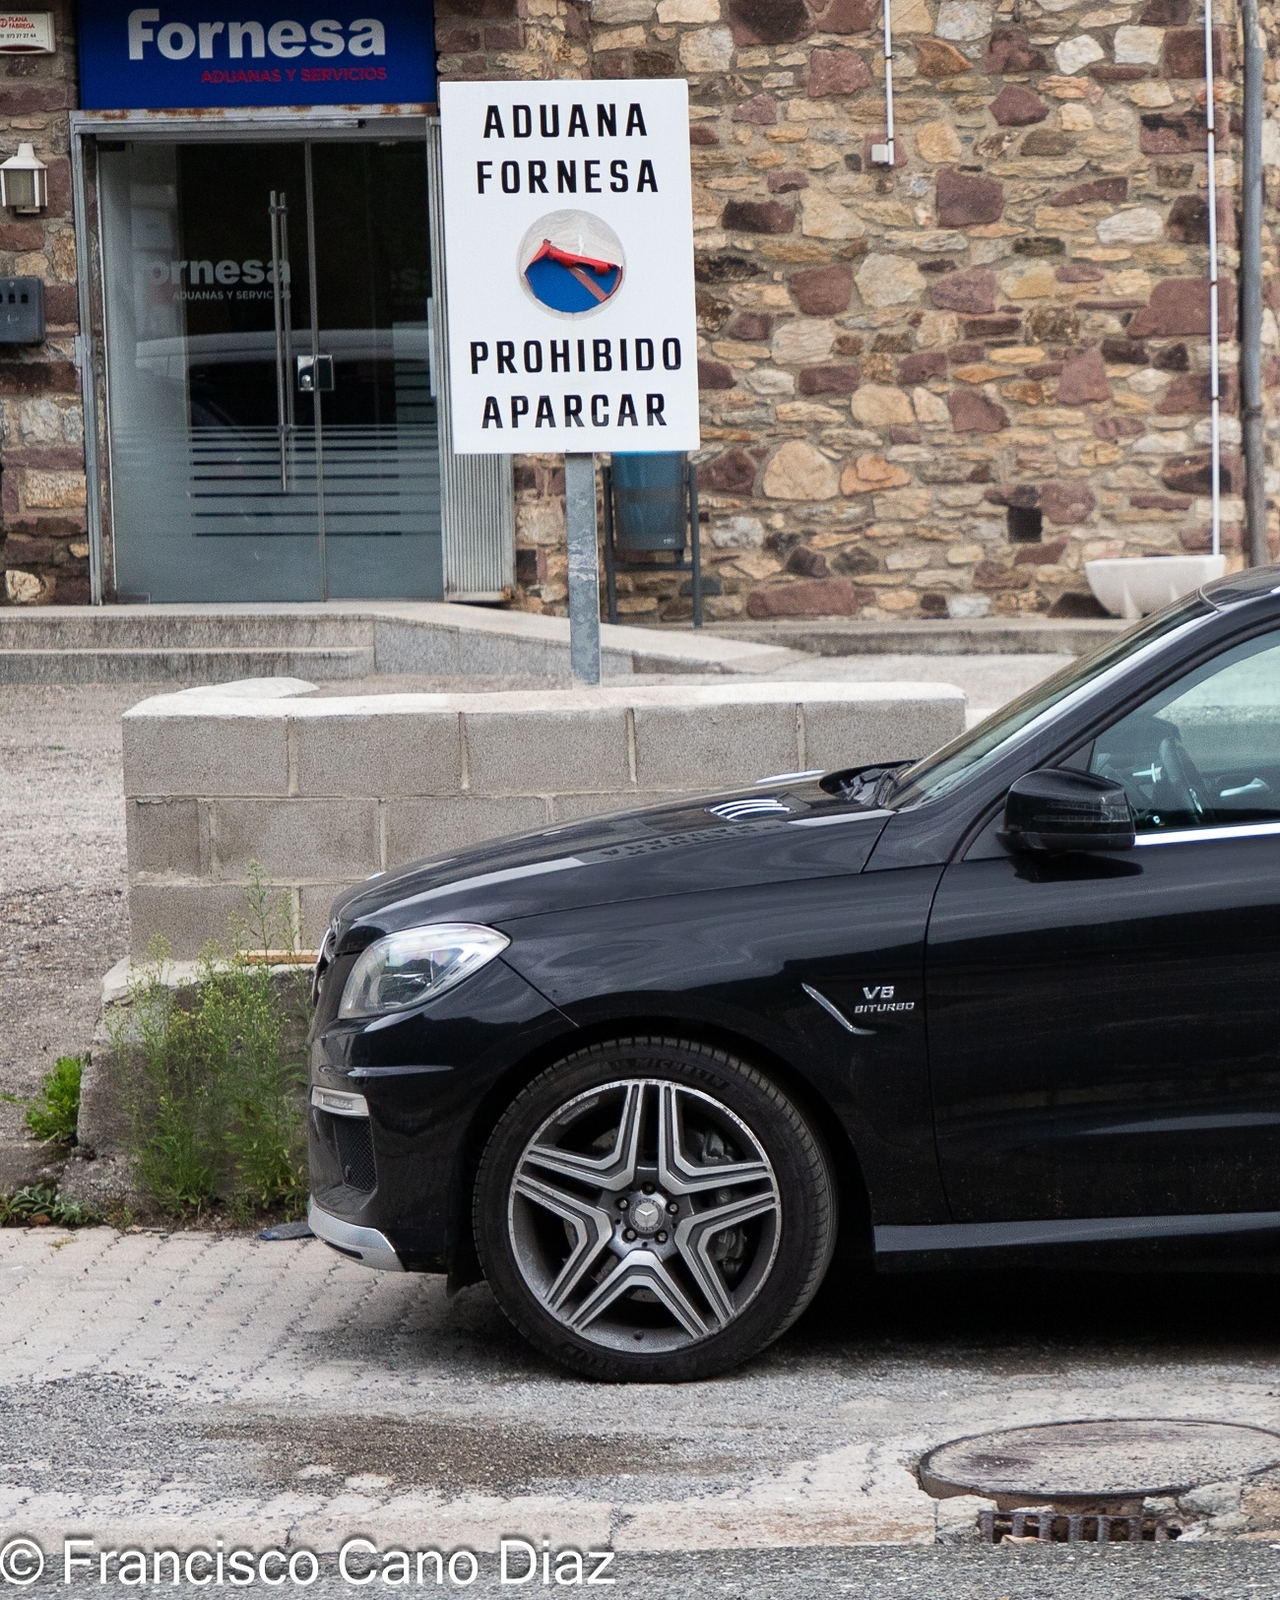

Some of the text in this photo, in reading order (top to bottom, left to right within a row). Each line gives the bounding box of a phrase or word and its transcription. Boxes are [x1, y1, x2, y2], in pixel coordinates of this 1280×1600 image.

[128, 8, 386, 60] Fornesa
[200, 67, 387, 83] ADUANAS Y SERVICIOS
[483, 103, 648, 138] ADUANA
[476, 159, 659, 194] FORNESA
[172, 290, 224, 300] ADUANAS
[470, 337, 682, 375] PROHIBIDO
[481, 393, 668, 429] APARCAR
[854, 1002, 915, 1014] BITURBO
[862, 985, 895, 1000] V8
